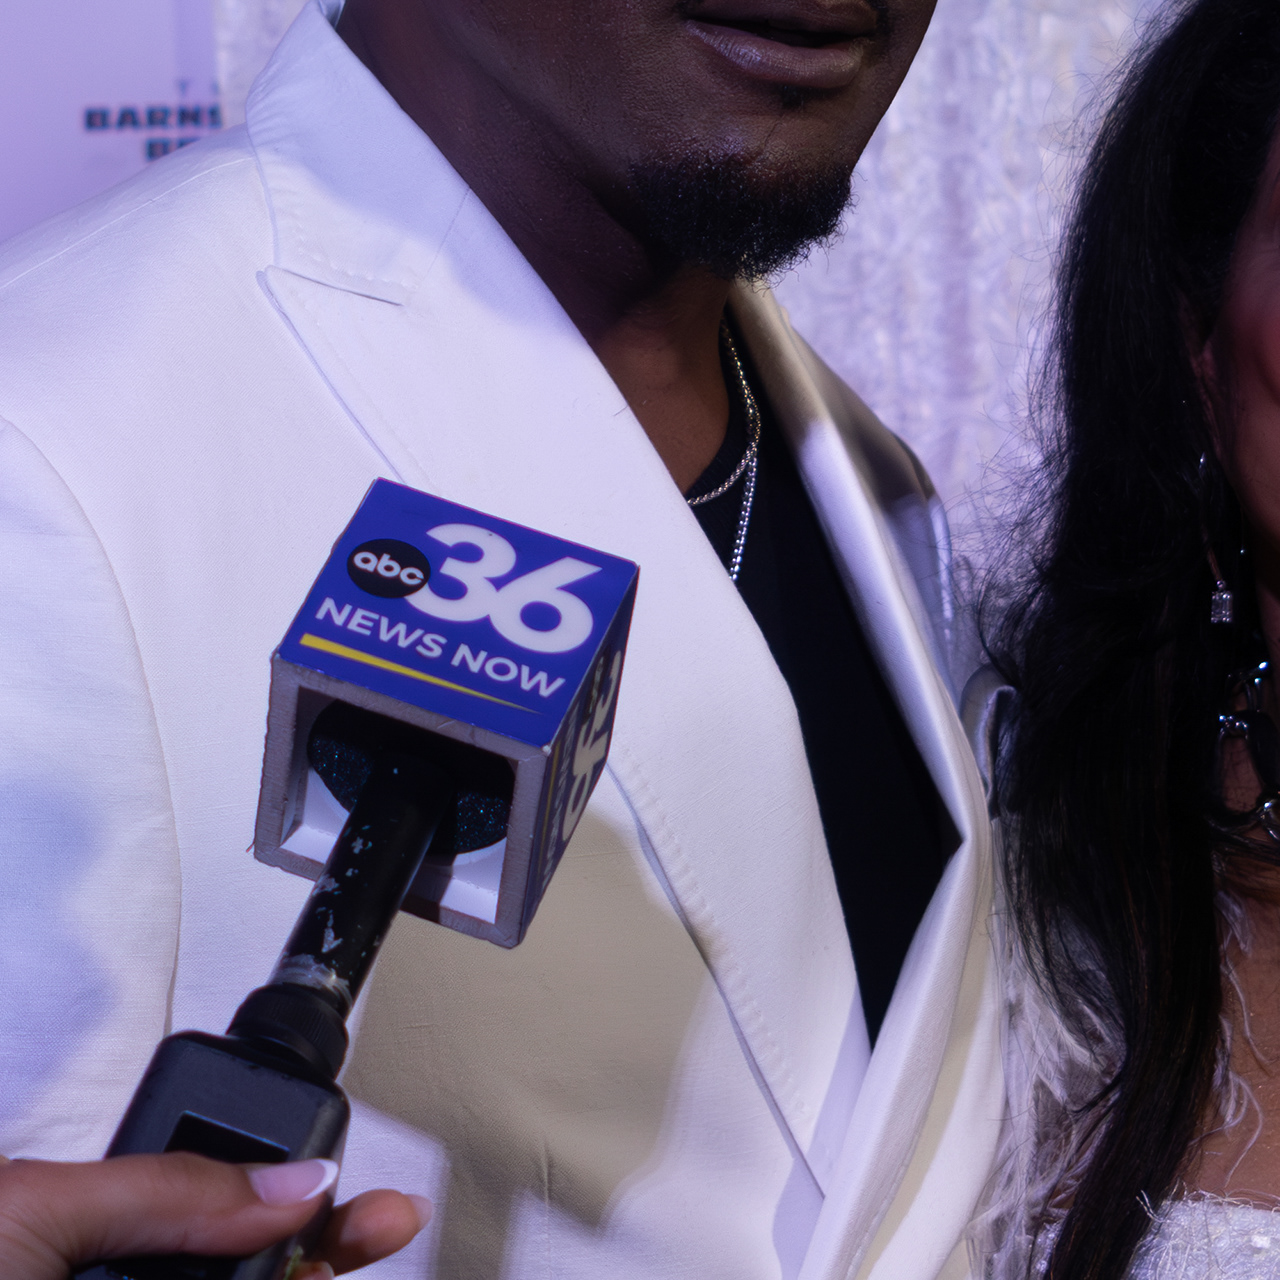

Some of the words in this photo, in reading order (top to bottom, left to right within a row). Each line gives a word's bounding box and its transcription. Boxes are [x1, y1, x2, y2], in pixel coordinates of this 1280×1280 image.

[85, 104, 222, 131] BARN
[352, 550, 425, 588] abc
[404, 523, 603, 653] 36
[315, 597, 448, 658] NEWS
[451, 644, 566, 699] NOW
